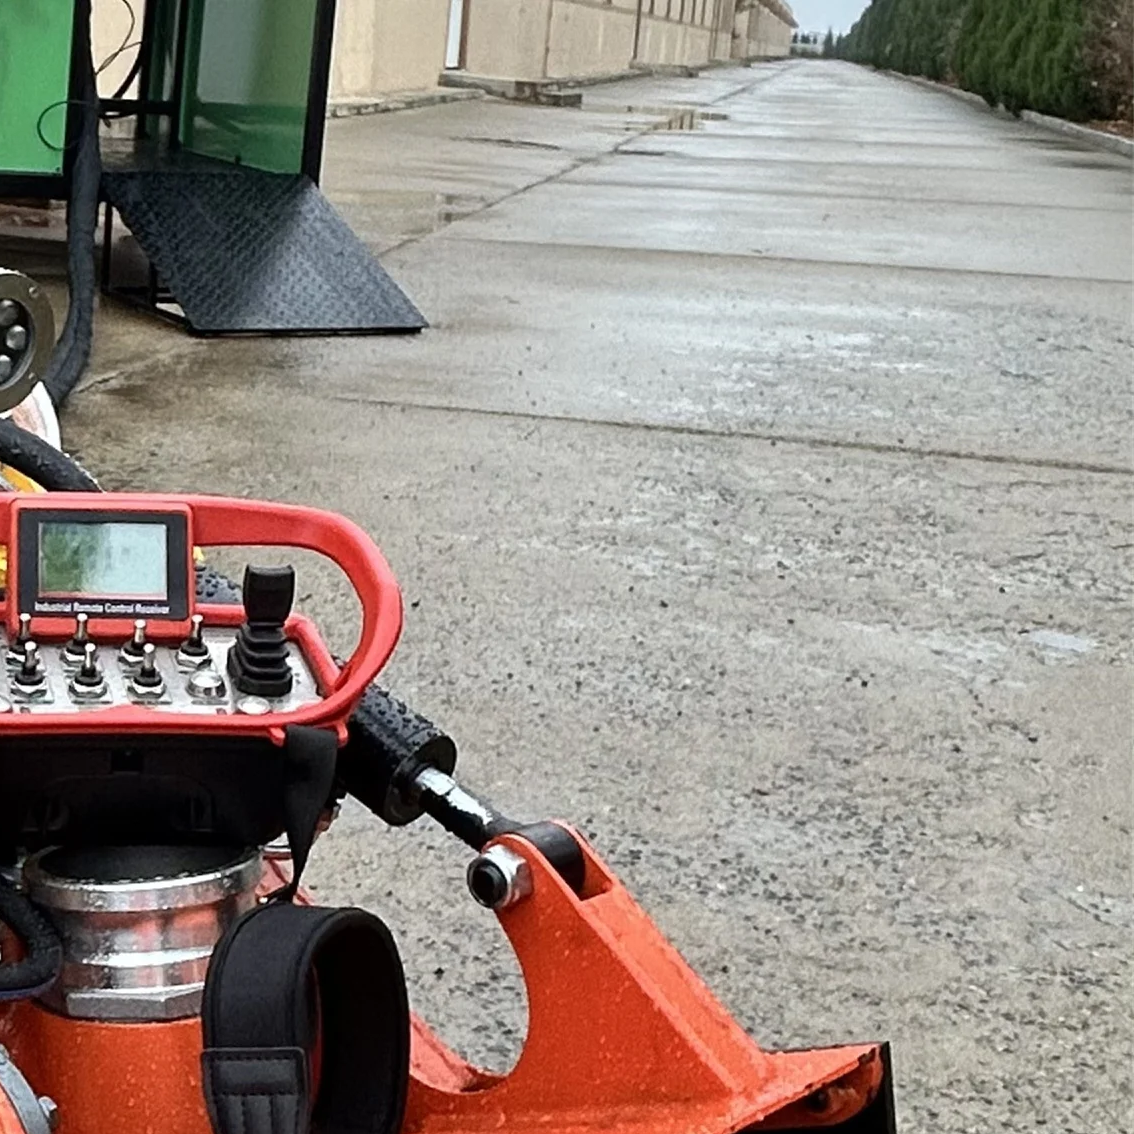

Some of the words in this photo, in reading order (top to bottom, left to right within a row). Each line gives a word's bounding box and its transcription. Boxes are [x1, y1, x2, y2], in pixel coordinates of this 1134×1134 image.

[34, 601, 72, 612] Industrial
[73, 602, 104, 613] Remote
[104, 602, 134, 614] Control
